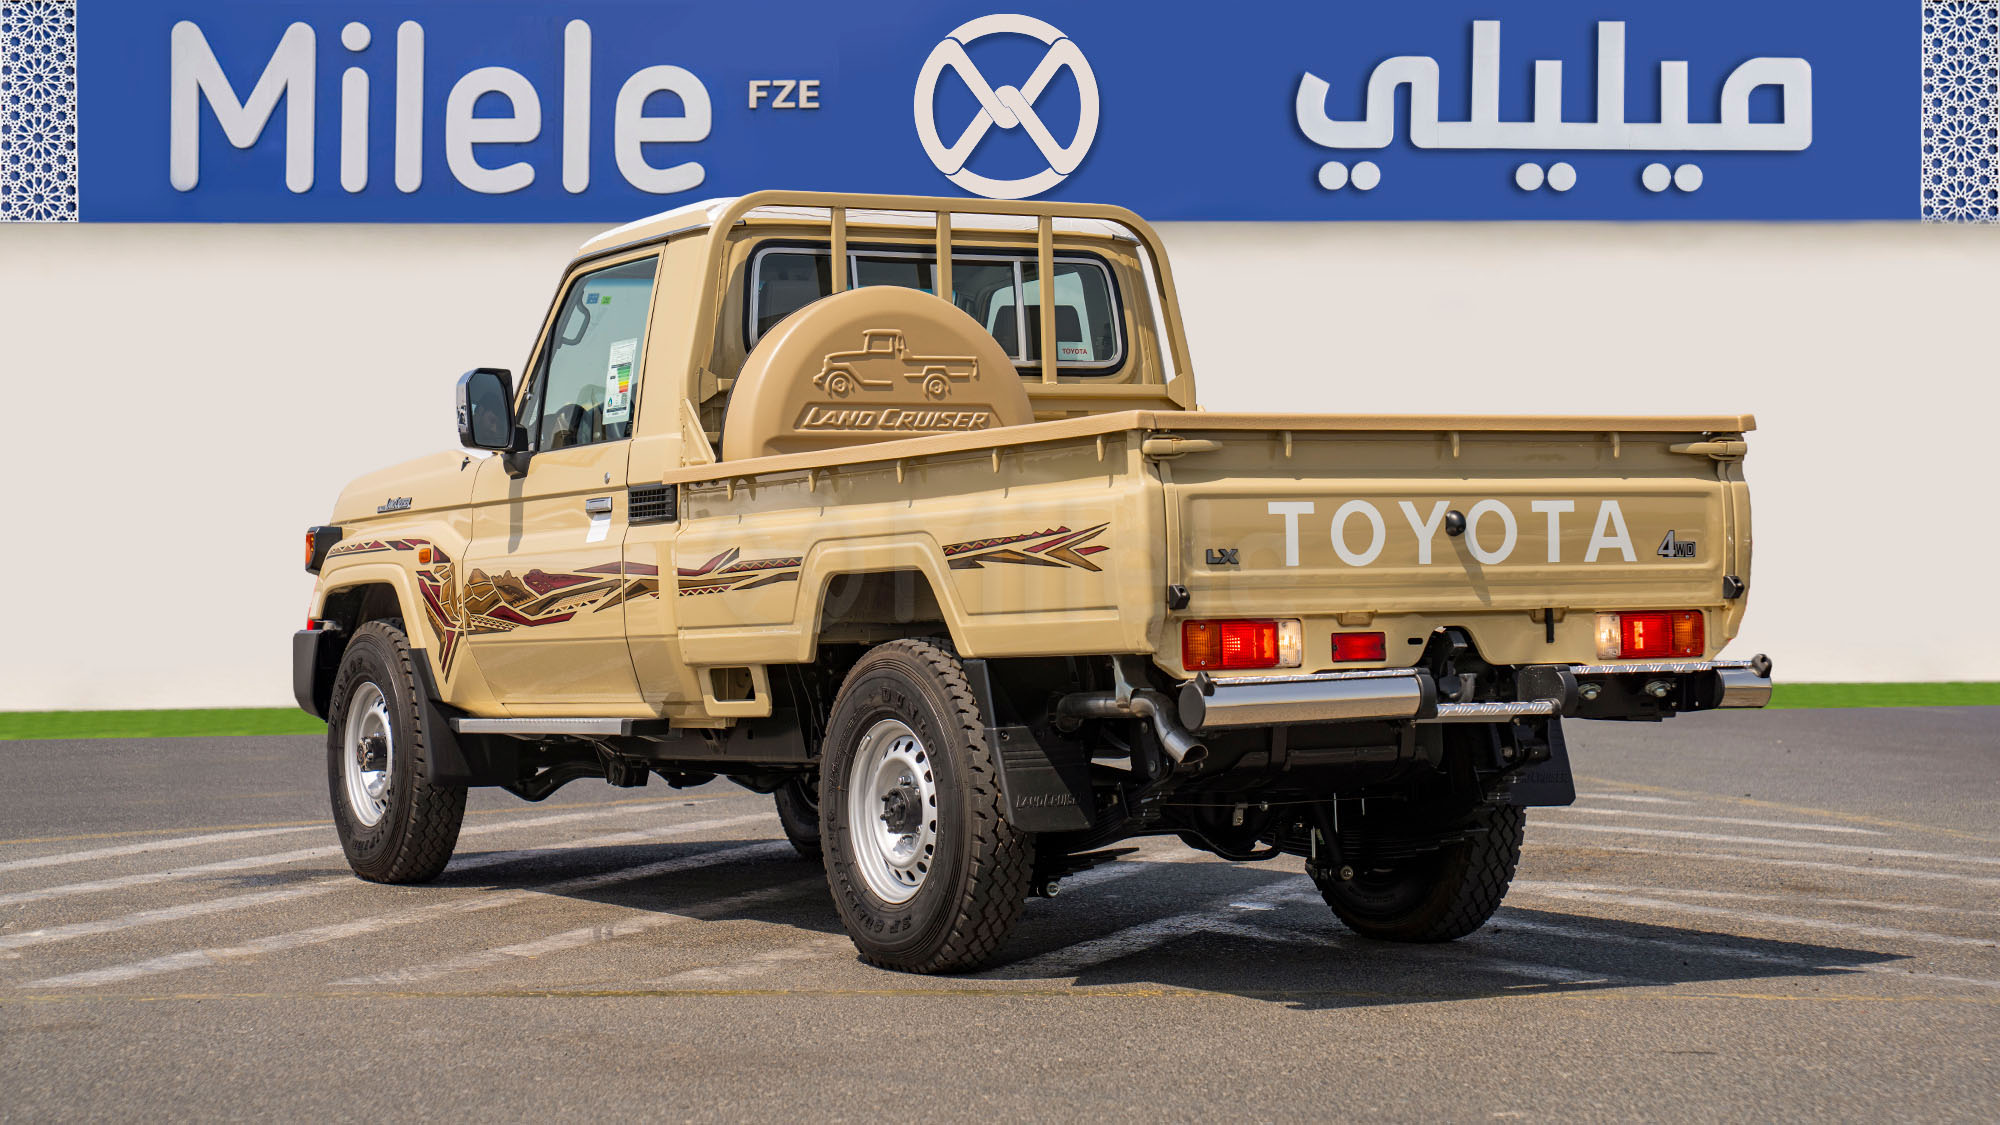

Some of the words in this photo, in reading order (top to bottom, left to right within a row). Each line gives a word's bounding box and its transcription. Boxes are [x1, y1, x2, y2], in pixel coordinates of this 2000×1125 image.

[170, 20, 713, 195] Milele
[748, 80, 821, 110] FZE
[1296, 20, 1813, 193] ميليلي
[803, 406, 876, 428] LAND
[878, 408, 989, 431] CRUISER
[1268, 499, 1638, 567] TOYOTA
[1657, 529, 1696, 558] 4WD
[1206, 548, 1240, 565] LX
